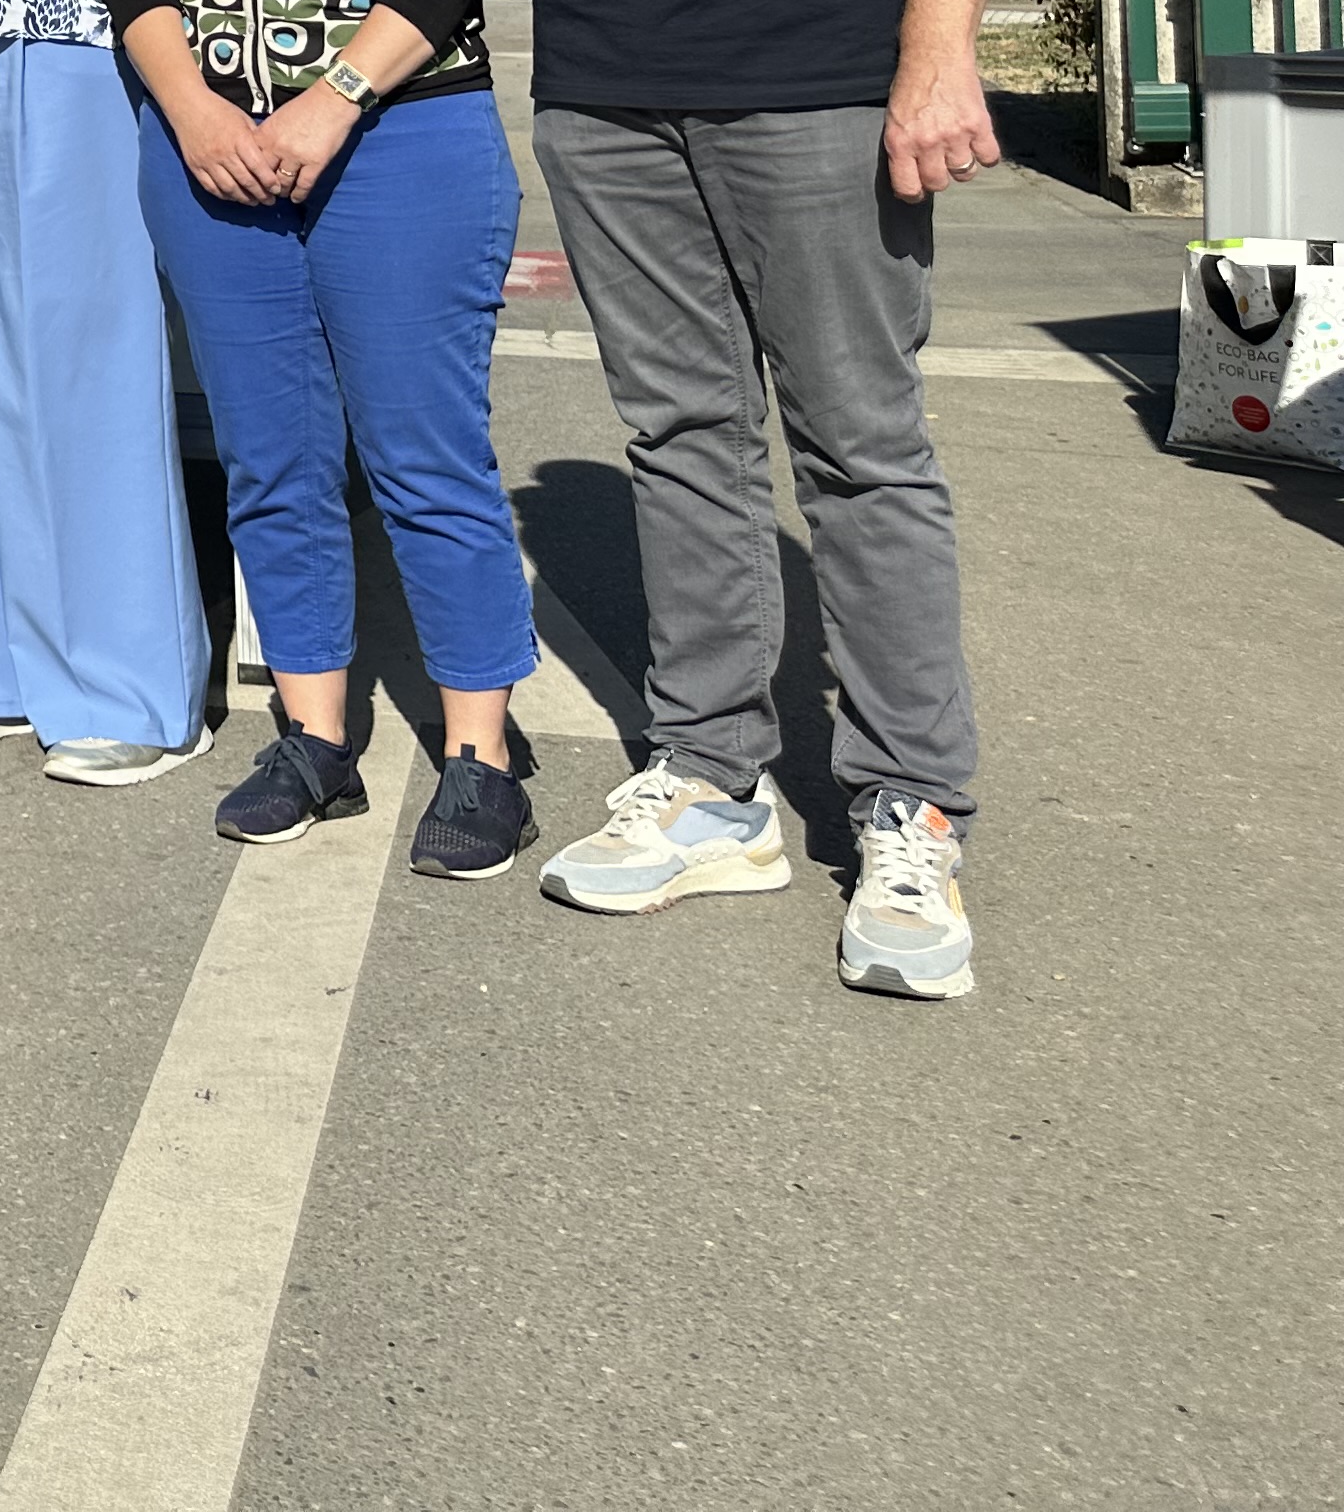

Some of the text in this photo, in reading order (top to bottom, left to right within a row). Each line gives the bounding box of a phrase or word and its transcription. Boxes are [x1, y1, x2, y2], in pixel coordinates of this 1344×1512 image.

[1216, 342, 1280, 363] ECO-BAG
[1218, 362, 1278, 384] FOR LIFE
